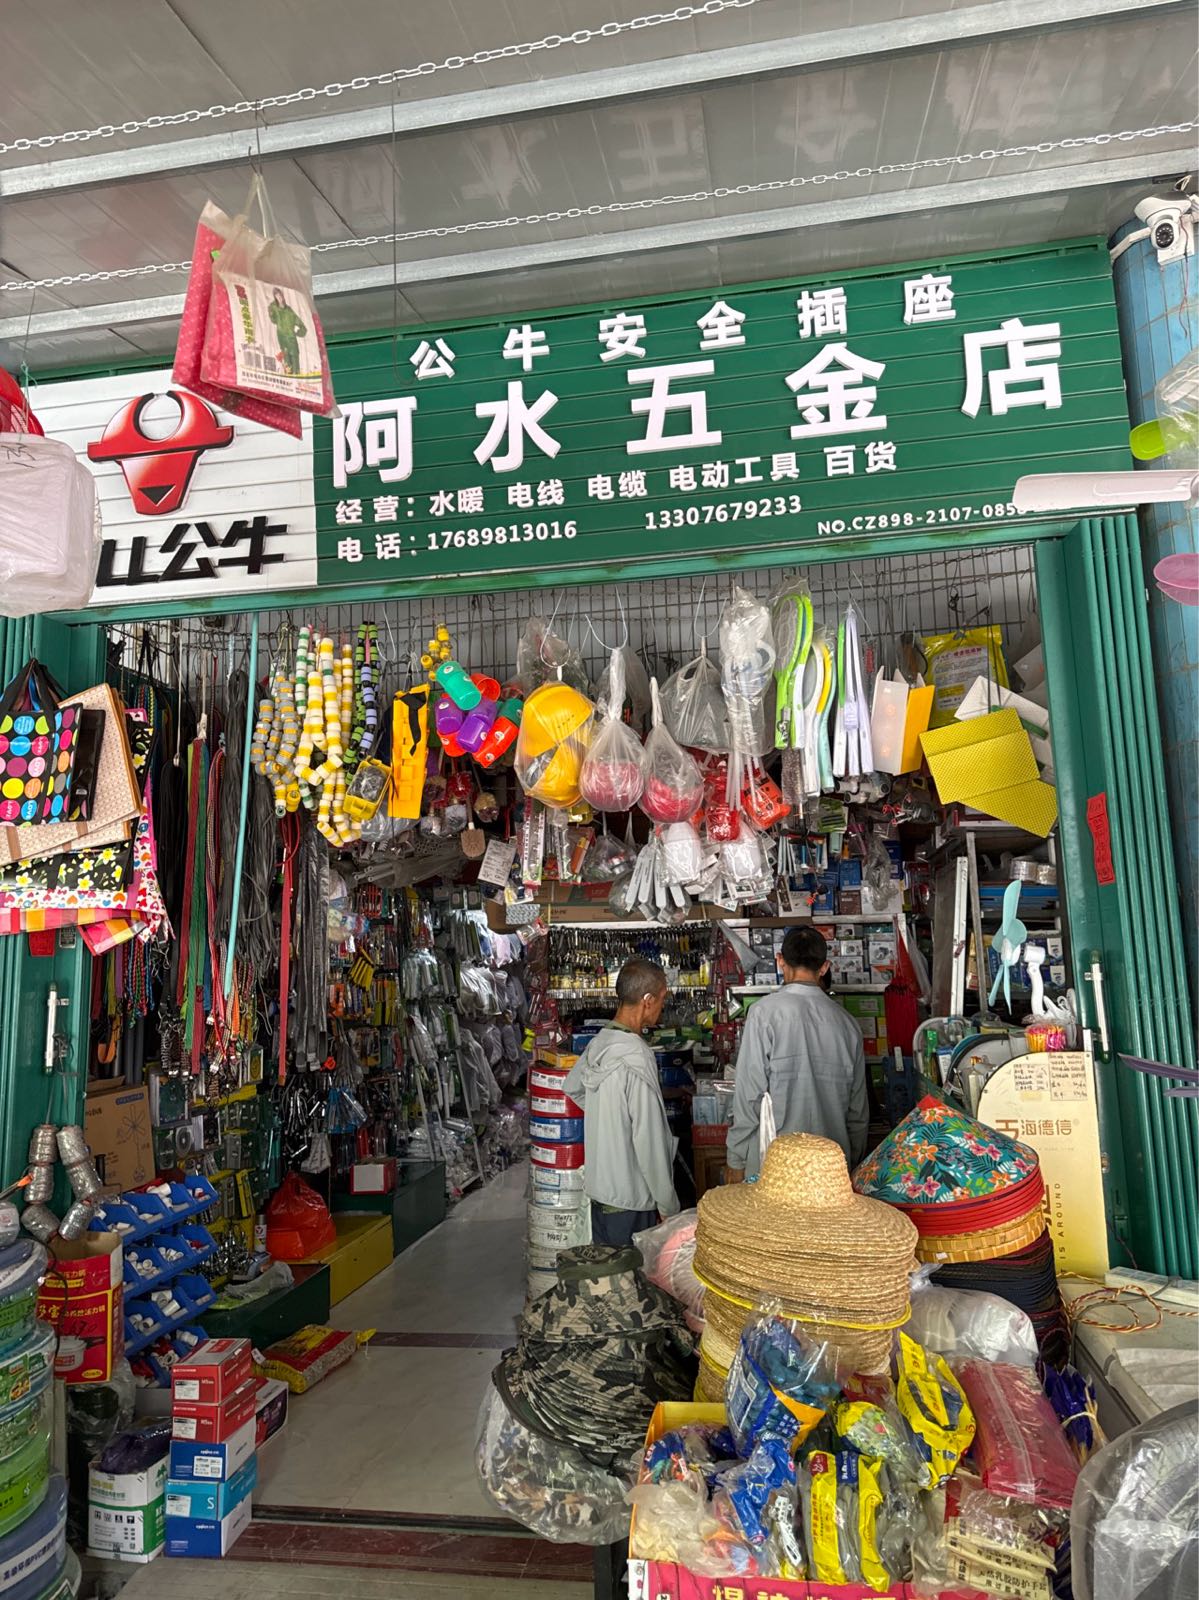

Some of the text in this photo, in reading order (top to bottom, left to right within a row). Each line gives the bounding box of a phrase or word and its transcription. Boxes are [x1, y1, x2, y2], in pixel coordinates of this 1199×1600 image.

[409, 274, 957, 380] 公牛安全插座
[332, 318, 1063, 489] 阿水五金店
[508, 479, 565, 508] 电线
[587, 470, 648, 499] 电缆
[669, 452, 800, 491] 电动工具
[824, 441, 897, 477] 百货
[645, 495, 802, 530] 13307679233
[1021, 1119, 1072, 1136] 海德信
[1055, 1182, 1065, 1238] AROUND
